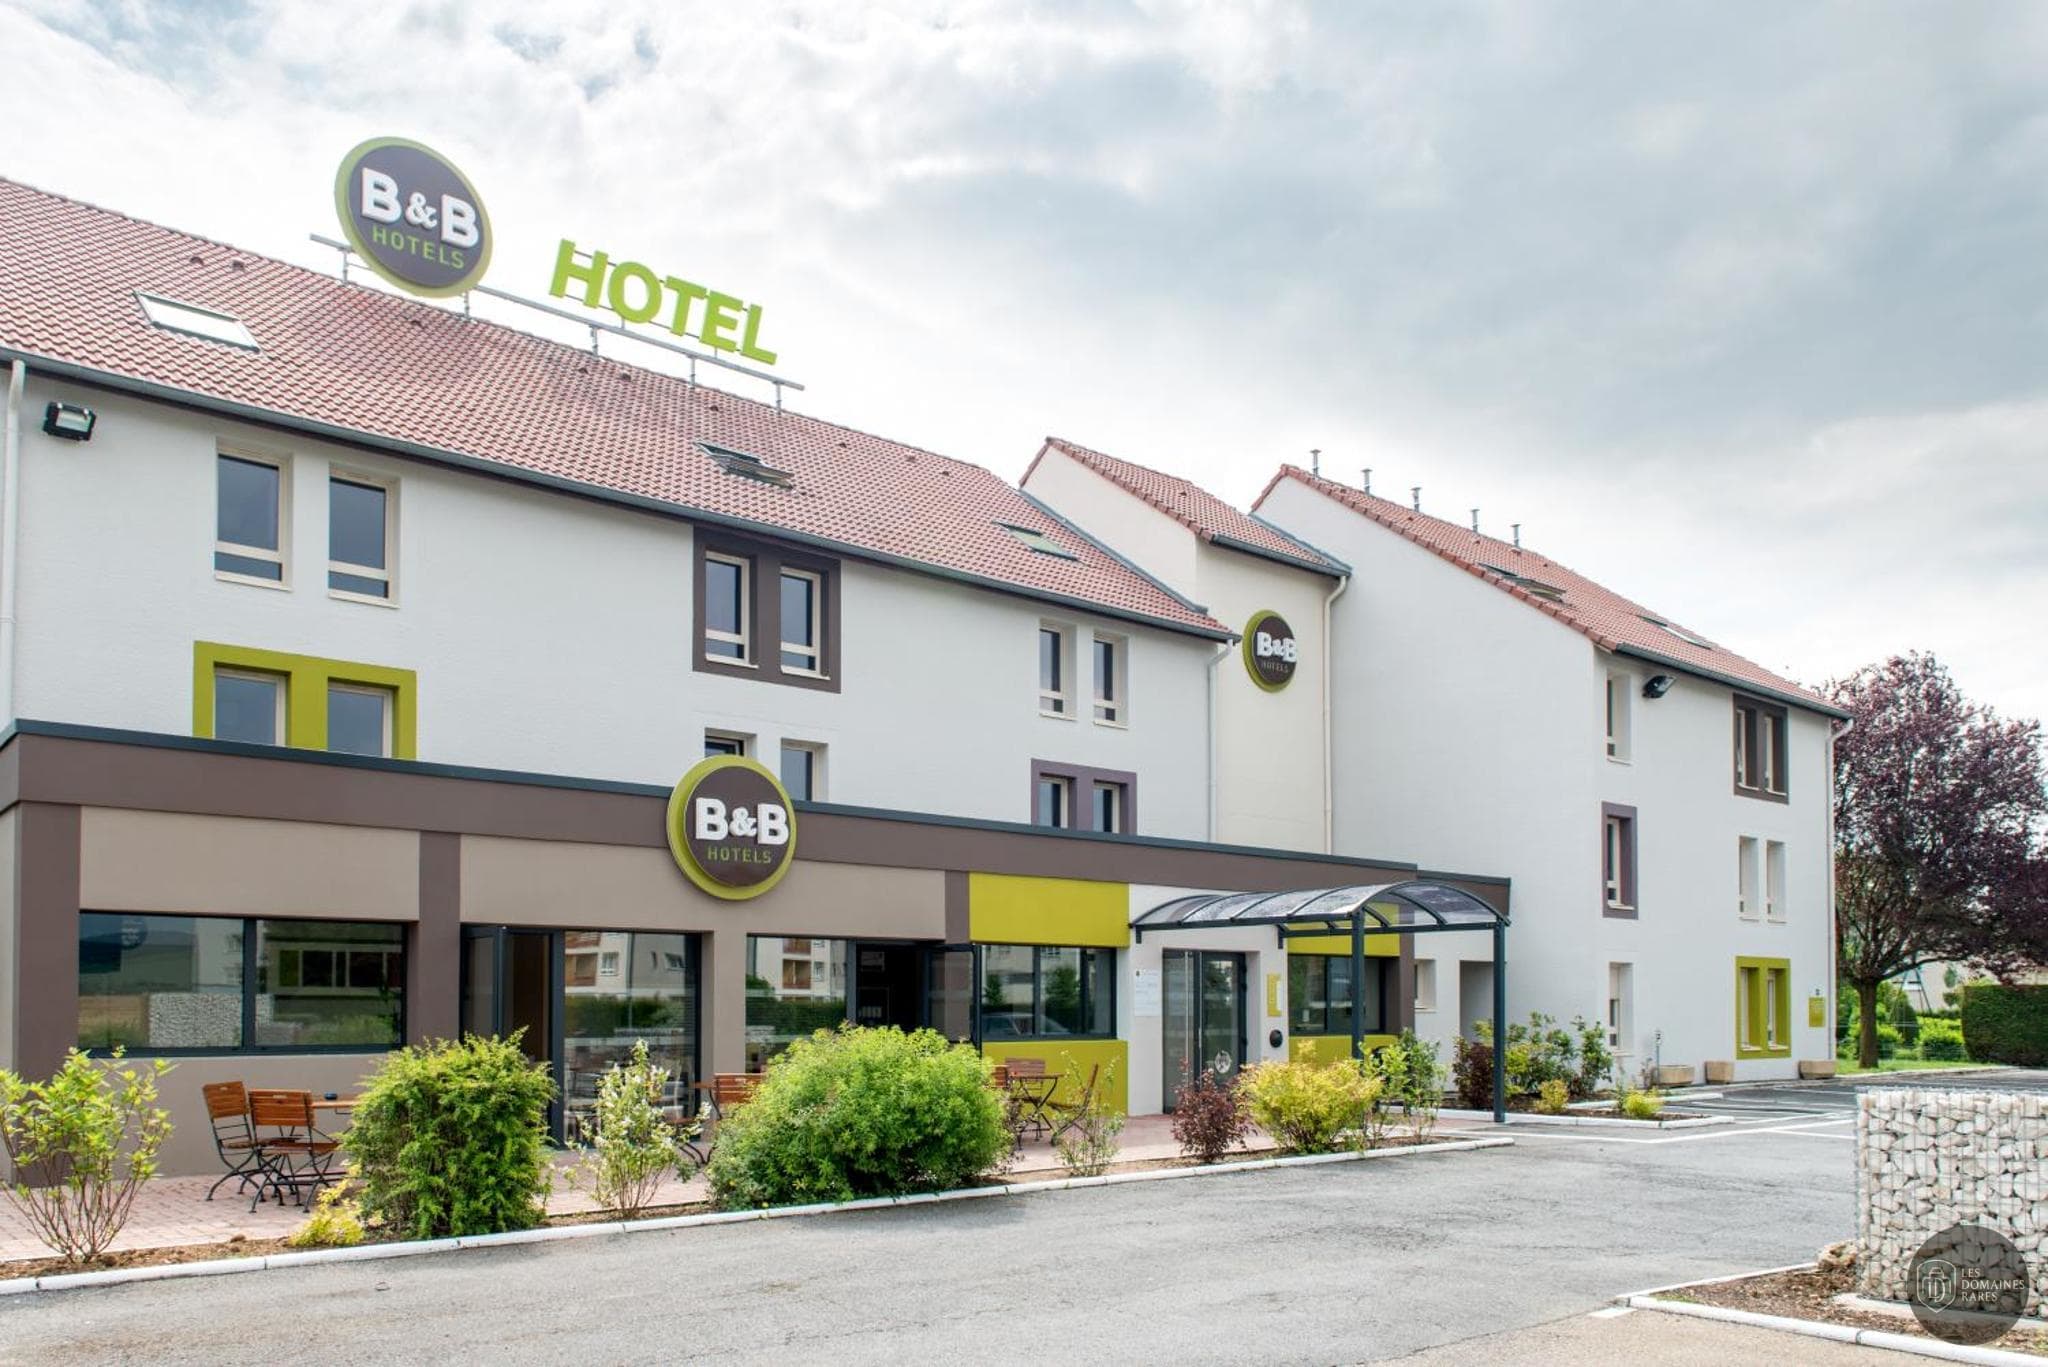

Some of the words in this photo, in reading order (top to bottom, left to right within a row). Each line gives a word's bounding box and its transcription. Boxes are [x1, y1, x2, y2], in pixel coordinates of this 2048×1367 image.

[361, 167, 479, 248] B&B
[371, 224, 465, 269] HOTELS
[549, 238, 778, 365] HOTEL
[695, 797, 789, 845] B&B
[707, 846, 771, 864] HOTELS
